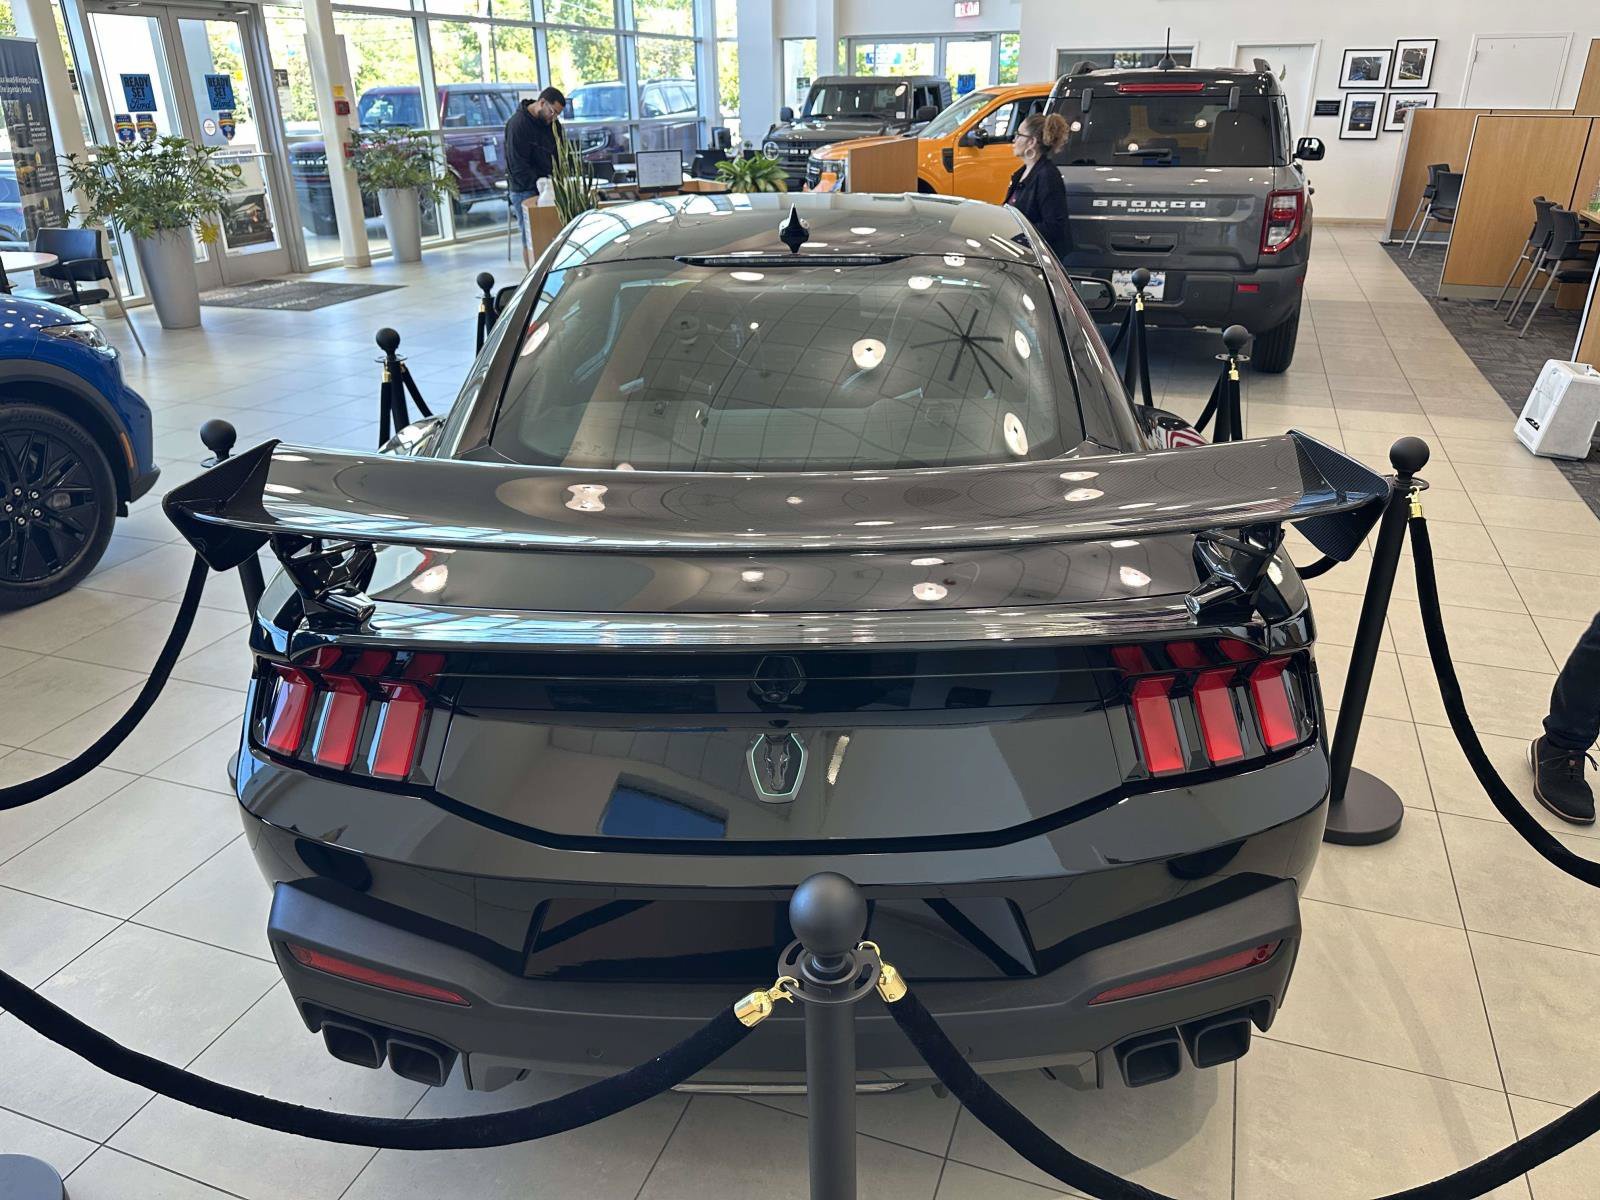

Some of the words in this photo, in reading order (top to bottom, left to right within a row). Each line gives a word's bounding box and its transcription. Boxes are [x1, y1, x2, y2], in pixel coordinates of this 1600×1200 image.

[123, 76, 149, 87] READY
[208, 76, 229, 87] READY
[131, 87, 145, 98] SET
[213, 86, 226, 97] SET
[1092, 199, 1206, 208] BRONCO
